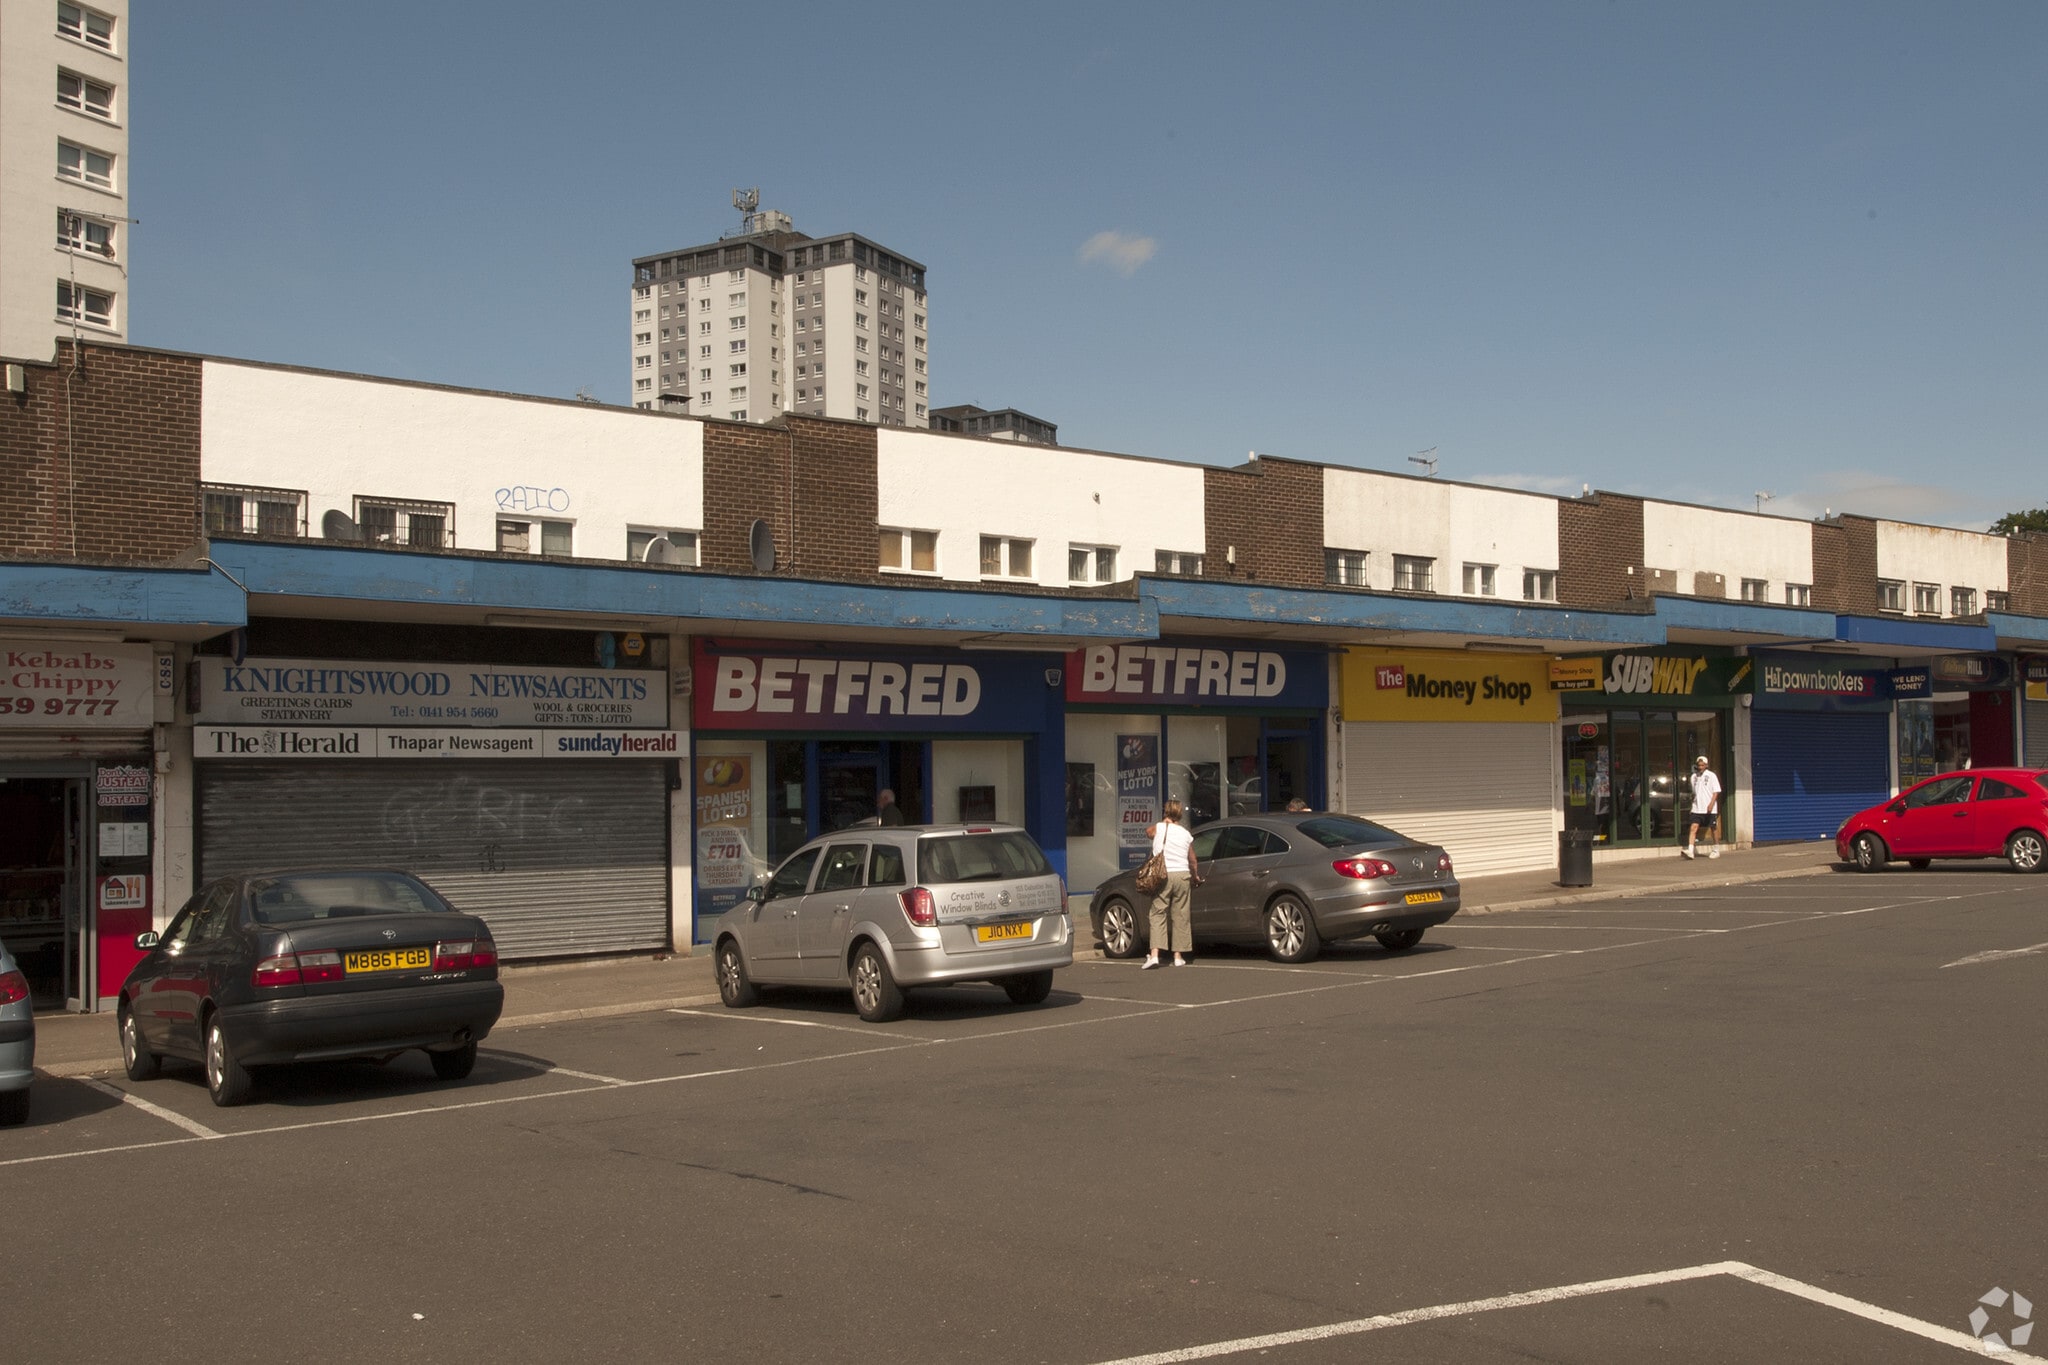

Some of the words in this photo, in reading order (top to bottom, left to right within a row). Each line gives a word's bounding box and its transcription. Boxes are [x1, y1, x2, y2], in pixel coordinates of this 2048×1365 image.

[7, 652, 116, 670] Kebabs
[1967, 660, 1983, 676] HILL
[1082, 644, 1286, 697] BETFRED
[1604, 655, 1708, 695] SUBWAY
[1728, 661, 1751, 692] SUBWAY
[1906, 674, 1926, 683] LEND
[12, 672, 121, 696] Chippy
[223, 667, 450, 696] KNIGHTSWOOD
[470, 673, 647, 700] NEWSAGENTS
[713, 656, 981, 716] BETFRED
[1379, 670, 1403, 687] The
[1406, 674, 1476, 705] Money
[1482, 675, 1531, 705] Shop
[1783, 668, 1863, 693] pawnbrokers
[1895, 682, 1922, 691] MONEY
[44, 698, 119, 716] 9777
[241, 697, 311, 708] GREETINGS
[313, 698, 353, 709] CARDS
[533, 702, 563, 713] WOOL
[566, 703, 574, 712] &
[577, 703, 632, 714] GROCERIES
[261, 709, 334, 720] STATIONERY
[419, 706, 443, 717] 0141
[446, 707, 467, 718] 954
[470, 707, 499, 718] 5660
[535, 713, 564, 723] GIFTS
[570, 714, 593, 723] TOYS
[600, 714, 632, 724] LOTTO
[210, 731, 259, 754] The
[280, 732, 360, 754] Herald
[388, 735, 444, 754] Thapar
[450, 736, 533, 752] Newsagent
[558, 732, 677, 756] sundayherald
[1118, 769, 1136, 780] NEW
[1137, 766, 1157, 777] YORK
[98, 777, 125, 787] JUST
[127, 777, 148, 787] EAT
[1123, 775, 1154, 791] LOTTO
[100, 796, 123, 804] JUST
[697, 790, 750, 809] SPANISH
[702, 803, 748, 823] LOTTO
[1122, 810, 1153, 823] £1001
[707, 844, 742, 860] £701
[951, 892, 985, 901] Creative
[940, 904, 972, 914] Window
[975, 901, 997, 911] Blinds
[988, 926, 1002, 939] J10
[1005, 924, 1023, 937] NXY
[349, 953, 392, 970] M886
[394, 950, 427, 965] FGB
